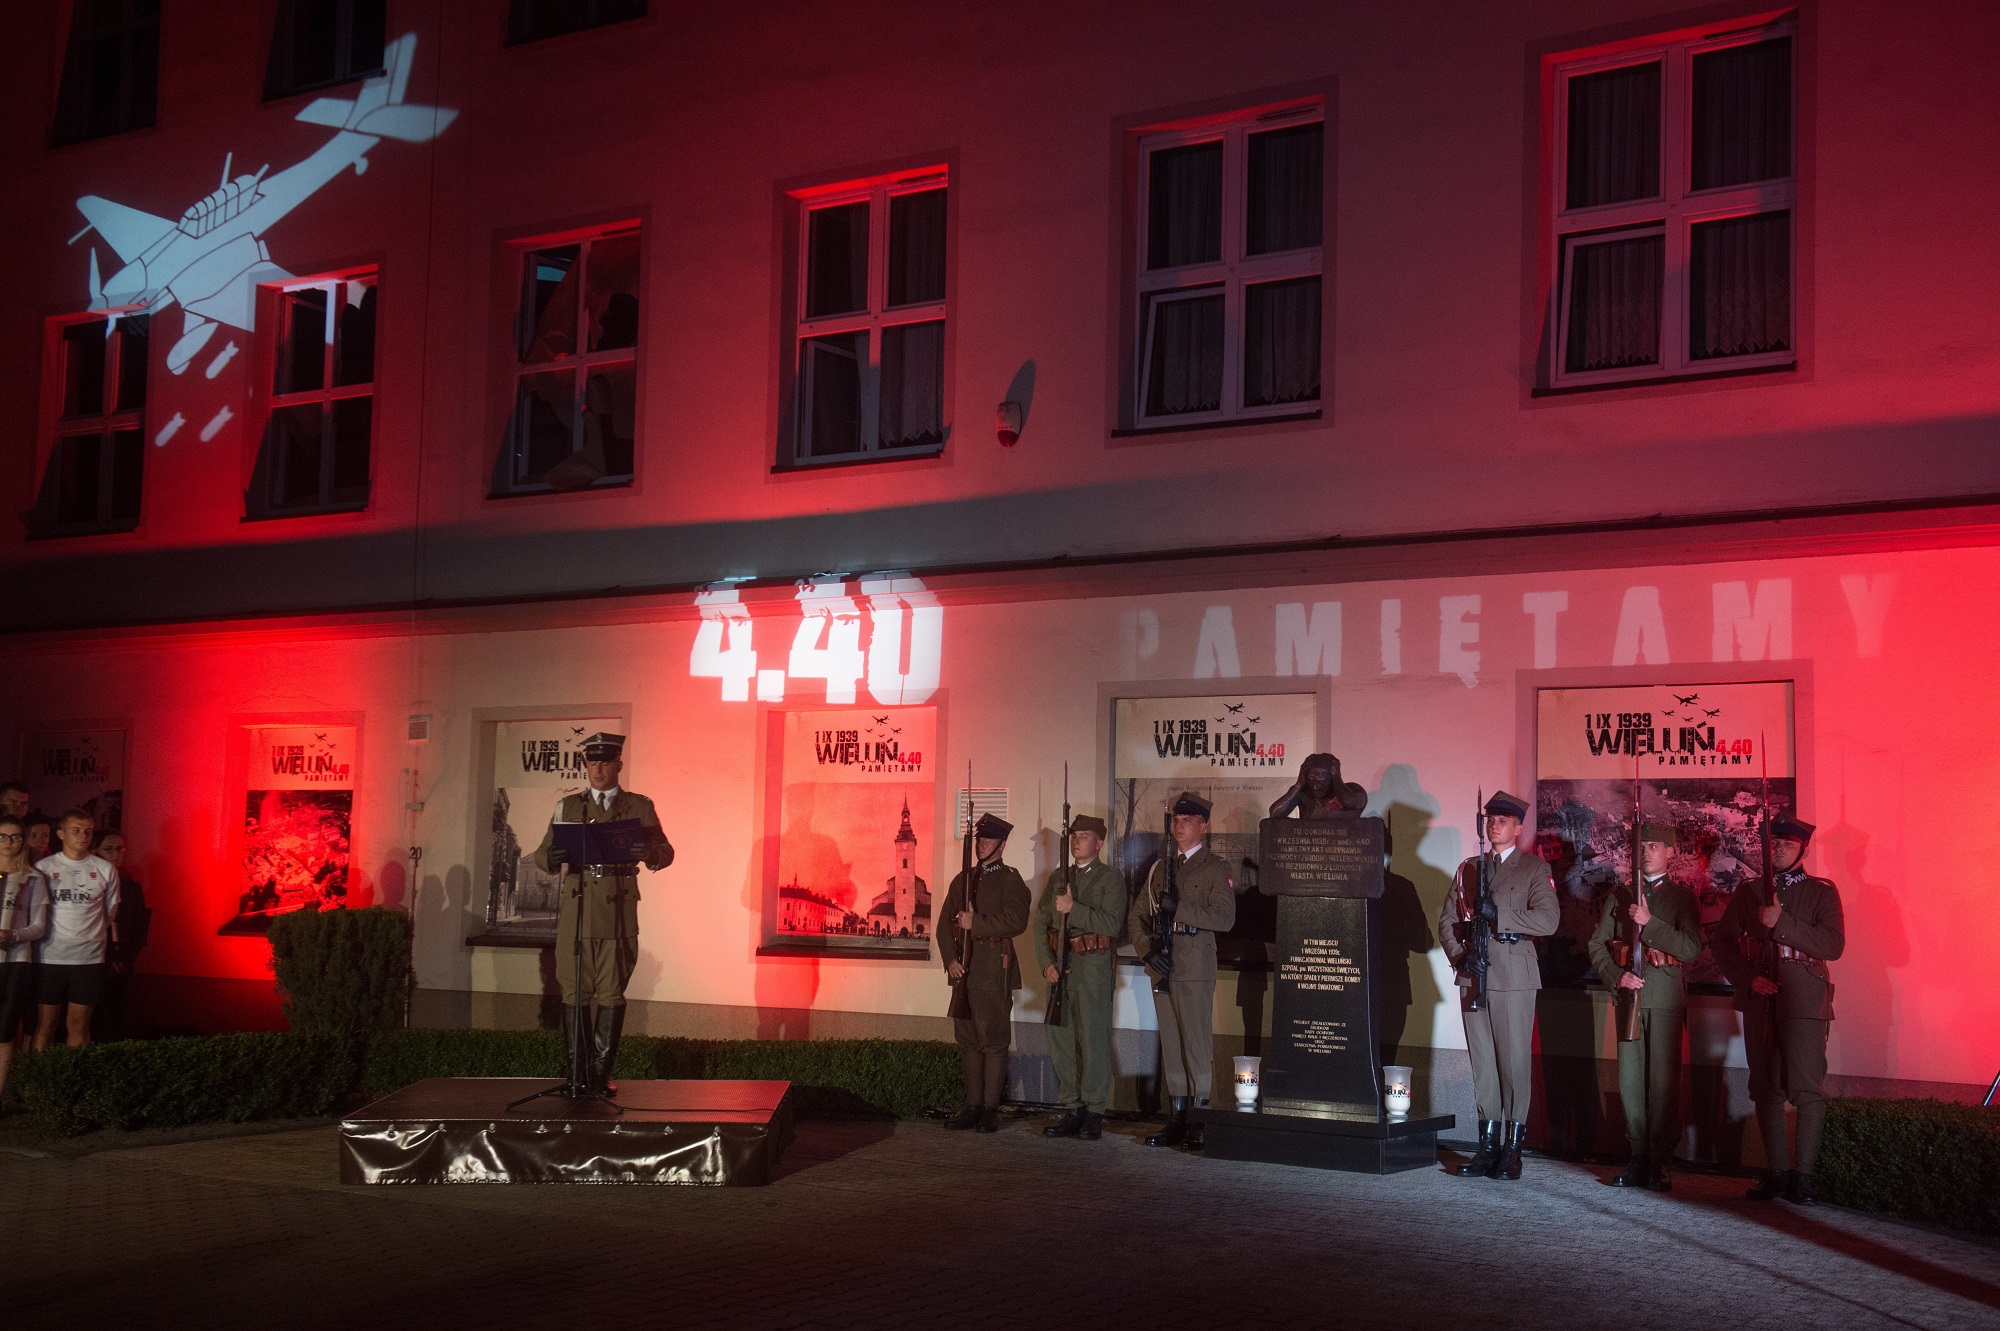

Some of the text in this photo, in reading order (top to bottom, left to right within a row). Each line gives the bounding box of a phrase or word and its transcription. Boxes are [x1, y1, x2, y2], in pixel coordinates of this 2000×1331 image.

[1120, 573, 1899, 689] PAMIĘTAMY
[689, 572, 943, 706] 4.40
[1154, 719, 1207, 734] 1 IX 1939
[1585, 713, 1652, 729] 1 IX 1939
[815, 730, 858, 743] 1 IX 1939
[1585, 721, 1753, 757] WIELUŃ 4.40
[522, 740, 559, 752] 1 IX 1939
[1154, 727, 1285, 759] WIELUŃ 4.40
[815, 737, 922, 766] WIELUŃ 4.40
[272, 752, 333, 775] WIELUŃ
[1211, 758, 1285, 767] PAMIĘTAMY
[1659, 755, 1753, 767] PAMIĘTAMY
[861, 765, 921, 773] PAMIĘTAMY
[561, 772, 587, 780] PAMIĘ
[1316, 873, 1348, 881] WIELUNIA
[1305, 947, 1327, 955] WRZEŚNIA
[1327, 957, 1352, 965] WIELUŃSKI
[1318, 983, 1344, 991] ŚWIATOWEJ
